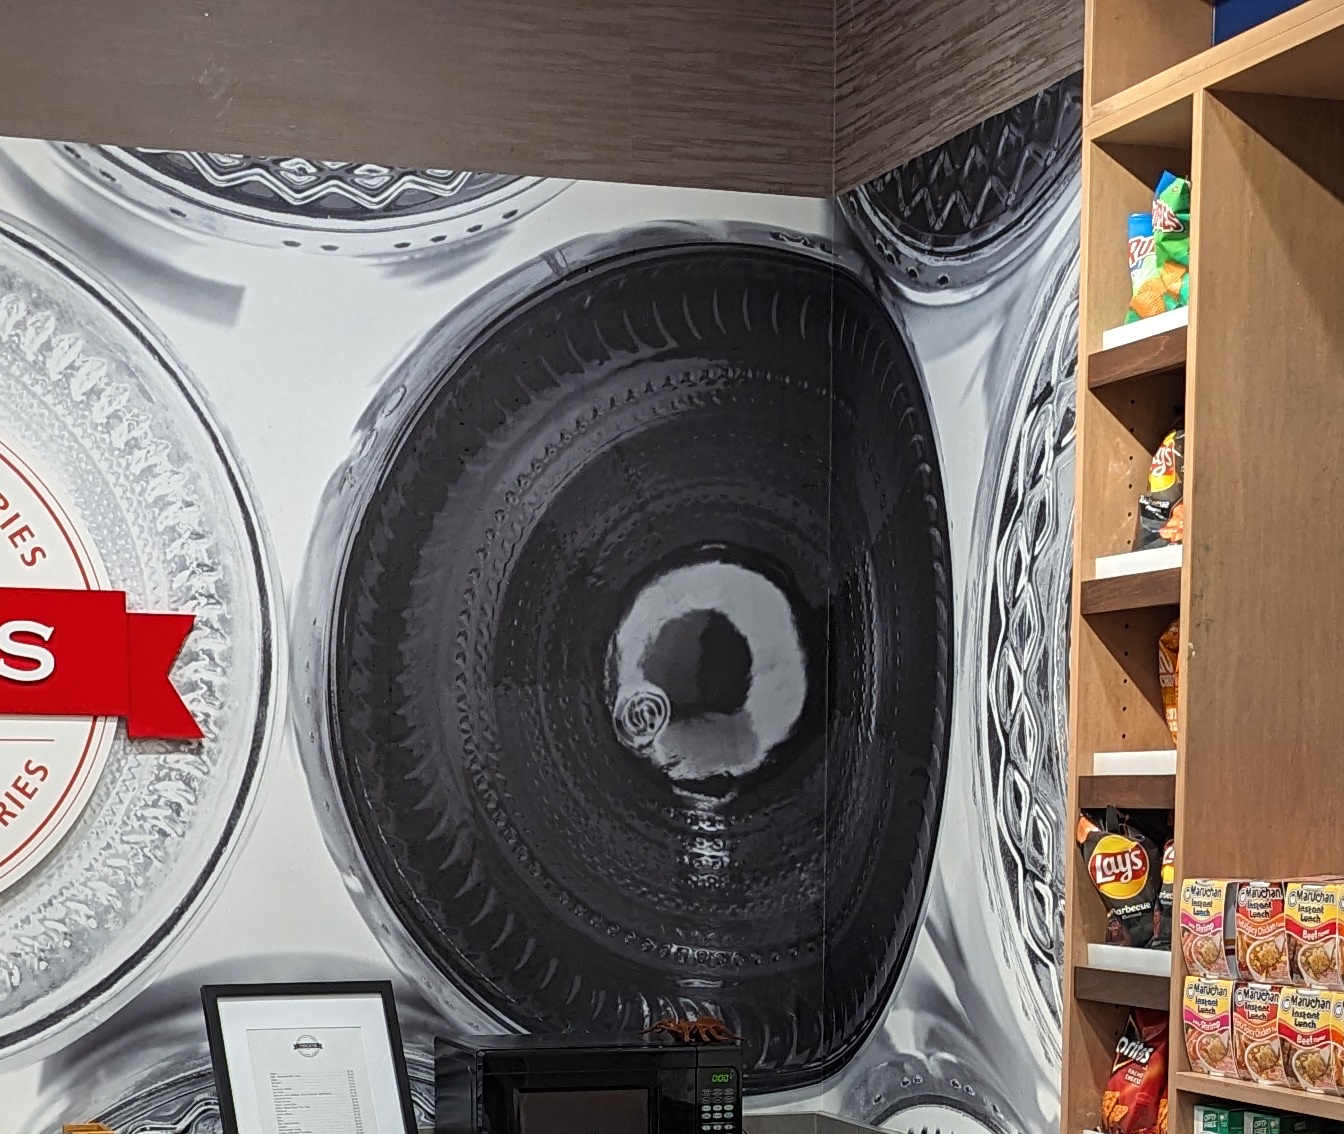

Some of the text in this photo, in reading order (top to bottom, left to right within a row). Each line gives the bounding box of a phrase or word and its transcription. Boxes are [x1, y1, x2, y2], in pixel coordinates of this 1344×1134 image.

[1096, 848, 1142, 884] Lay's
[1190, 885, 1222, 898] Maruchan
[1246, 886, 1282, 899] Maruchan
[1296, 891, 1335, 904] Maruchan
[1193, 983, 1228, 997] Maruchan
[1243, 988, 1279, 1001] Maruchan
[1290, 994, 1331, 1009] Maruchan
